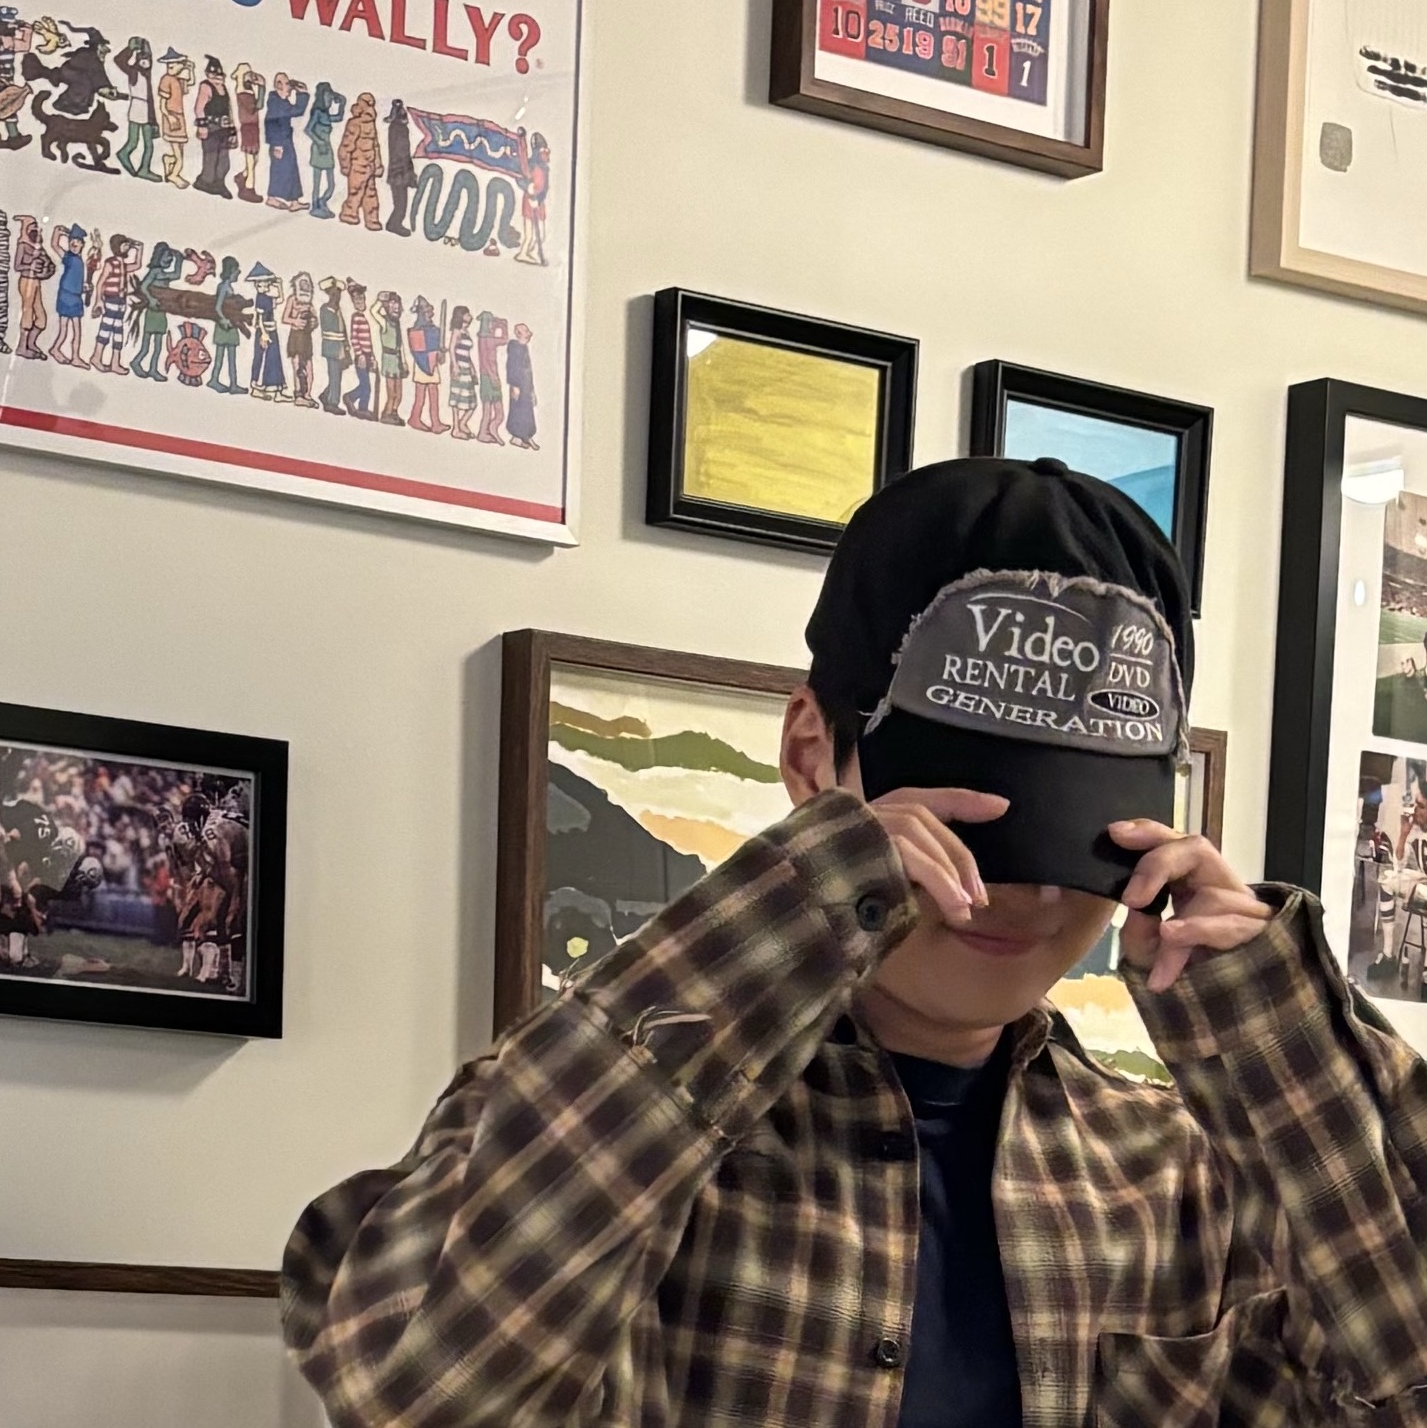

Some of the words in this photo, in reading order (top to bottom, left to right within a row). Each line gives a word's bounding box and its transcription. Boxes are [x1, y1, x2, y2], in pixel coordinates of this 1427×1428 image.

[905, 7, 934, 28] REED
[1015, 2, 1042, 35] 17
[832, 6, 864, 42] 10
[868, 20, 900, 52] 25
[902, 27, 934, 60] 19
[983, 43, 998, 79] 1
[1021, 60, 1031, 87] 1
[967, 603, 1100, 672] Video
[1111, 625, 1155, 656] 1990
[942, 654, 1076, 701] RENTAL
[1108, 662, 1151, 688] DVD
[925, 685, 1163, 742] GENERATION
[1107, 693, 1150, 715] VIDEO
